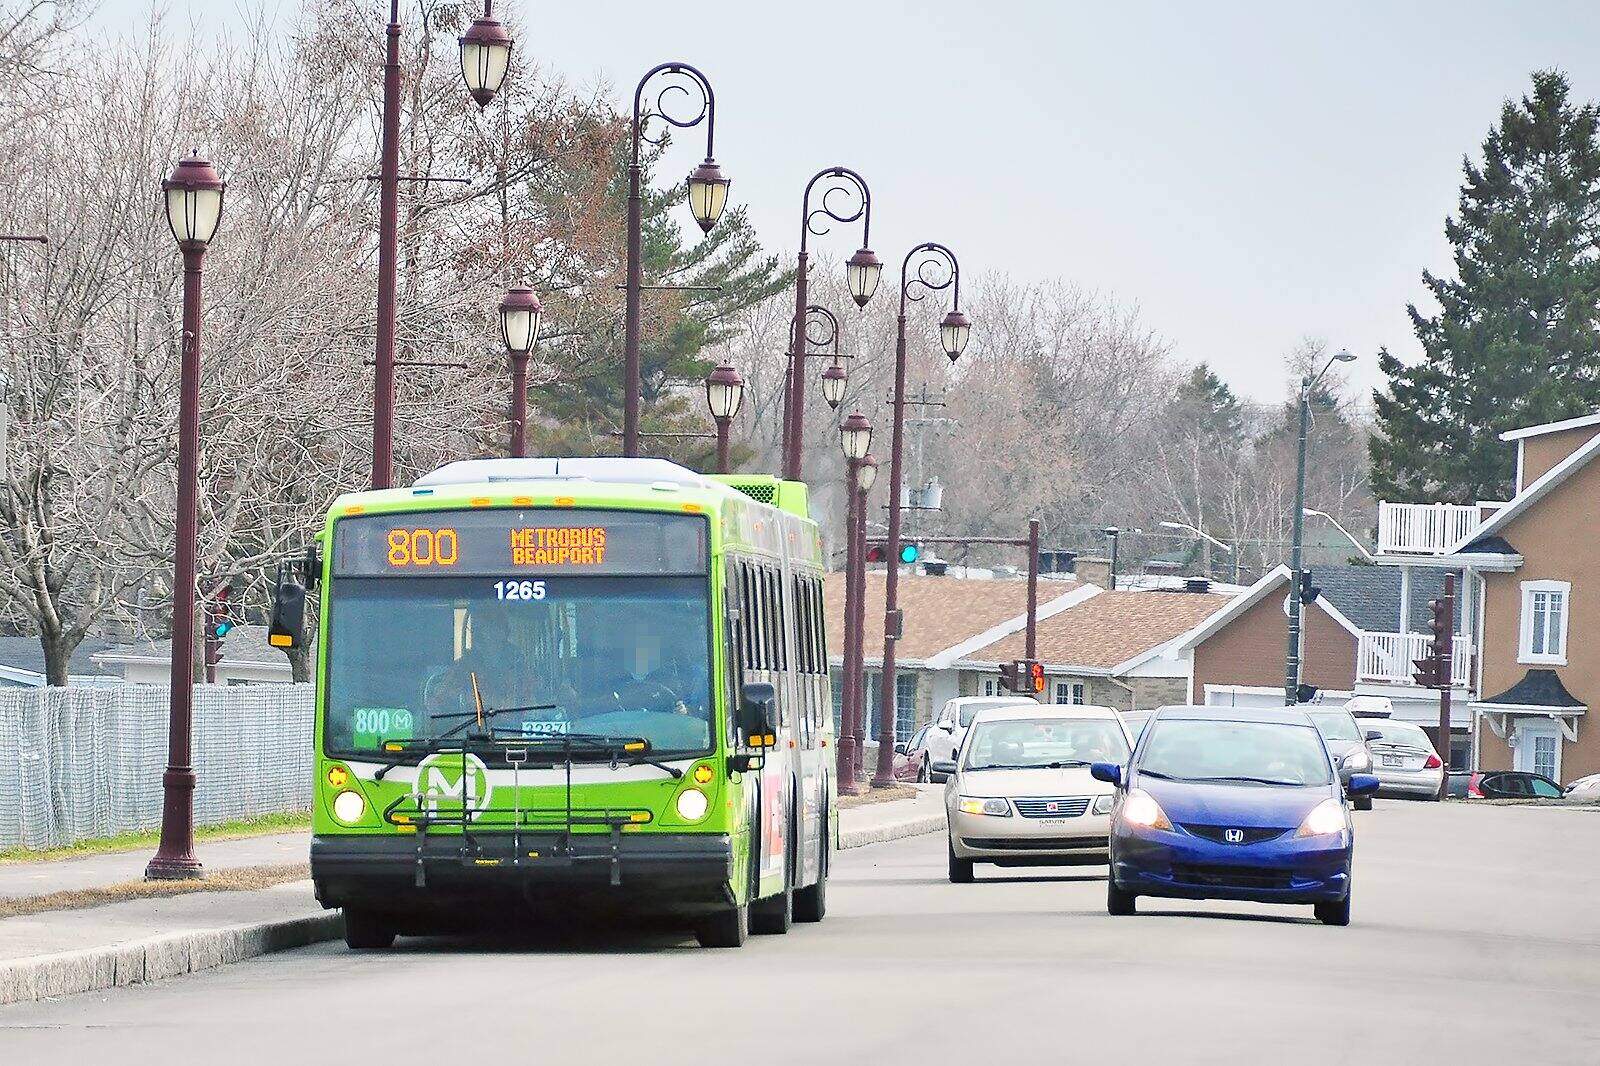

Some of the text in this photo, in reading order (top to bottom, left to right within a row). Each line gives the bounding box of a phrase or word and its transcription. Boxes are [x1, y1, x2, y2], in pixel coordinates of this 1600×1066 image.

[387, 528, 457, 566] 800
[511, 528, 606, 547] METROBUS
[513, 547, 605, 565] BEAUPORT
[494, 580, 546, 600] 1265
[356, 709, 390, 733] 800
